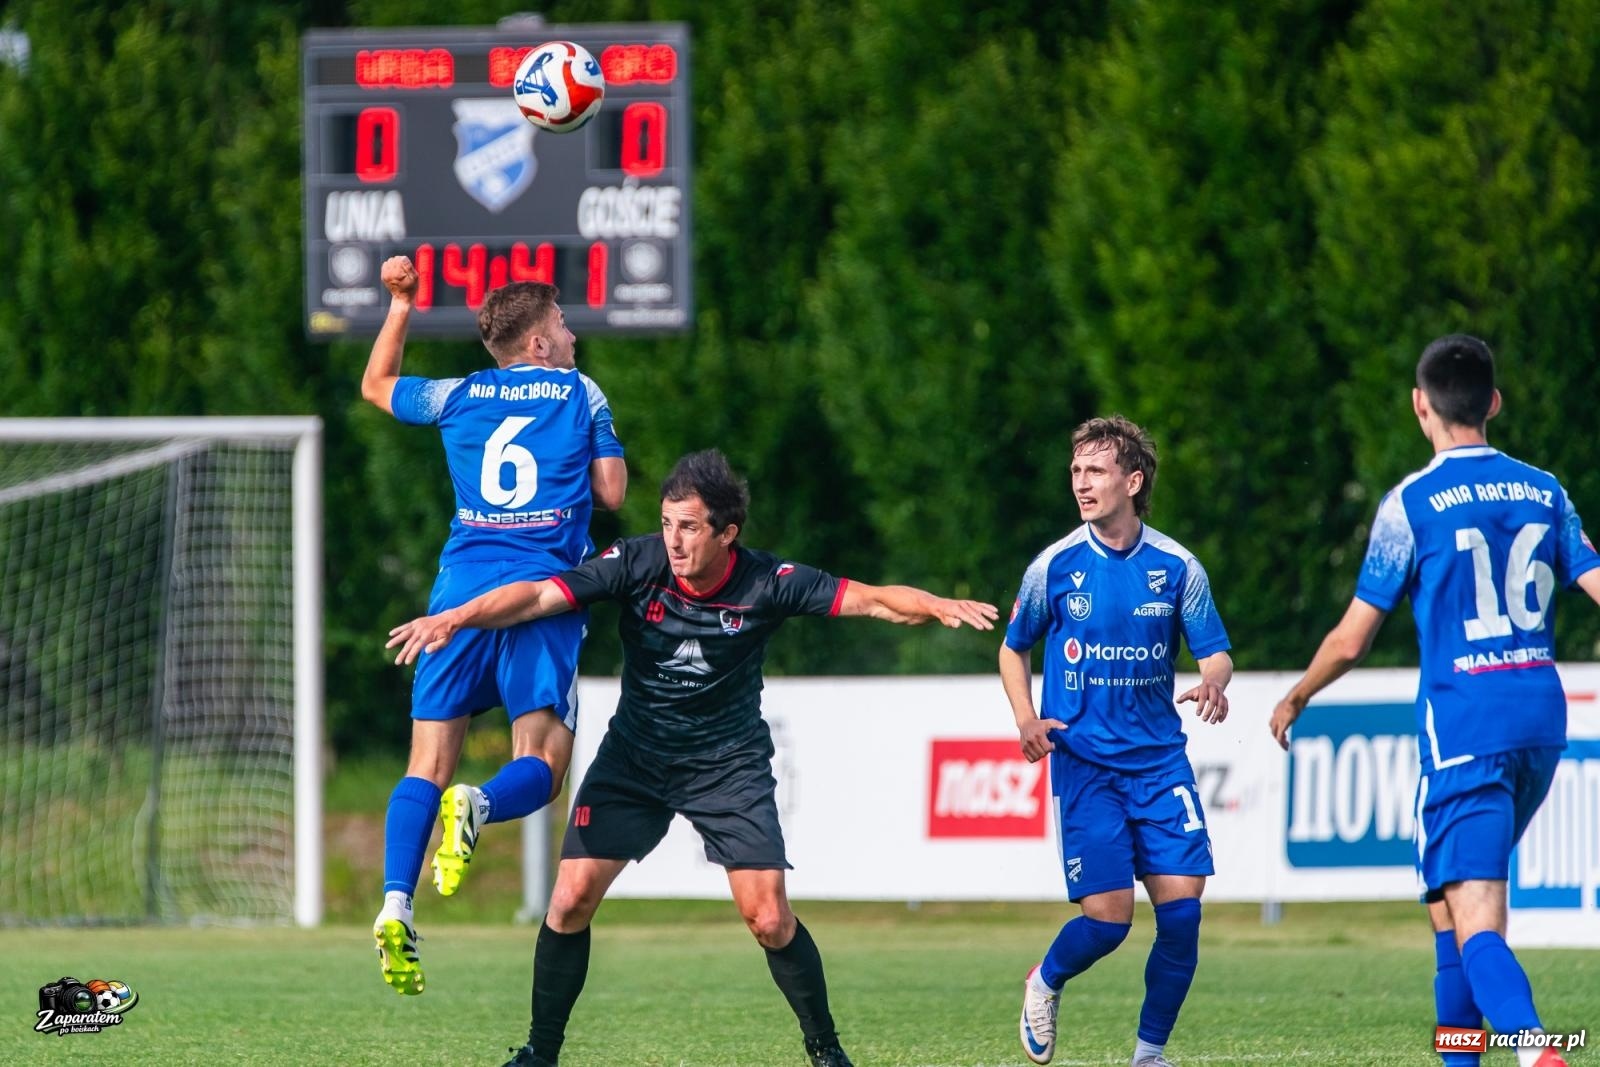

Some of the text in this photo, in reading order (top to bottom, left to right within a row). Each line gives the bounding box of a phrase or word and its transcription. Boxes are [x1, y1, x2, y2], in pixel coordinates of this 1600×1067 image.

[356, 107, 399, 182] 0
[621, 102, 667, 178] 0
[325, 190, 406, 243] UNIA
[577, 175, 682, 239] GOŚCIE
[481, 416, 538, 509] 6
[1429, 484, 1474, 513] UNIA
[1455, 523, 1555, 641] 16
[1085, 642, 1149, 661] Marco
[1089, 677, 1105, 686] MB
[574, 806, 590, 827] 10
[934, 758, 1042, 818] nasz
